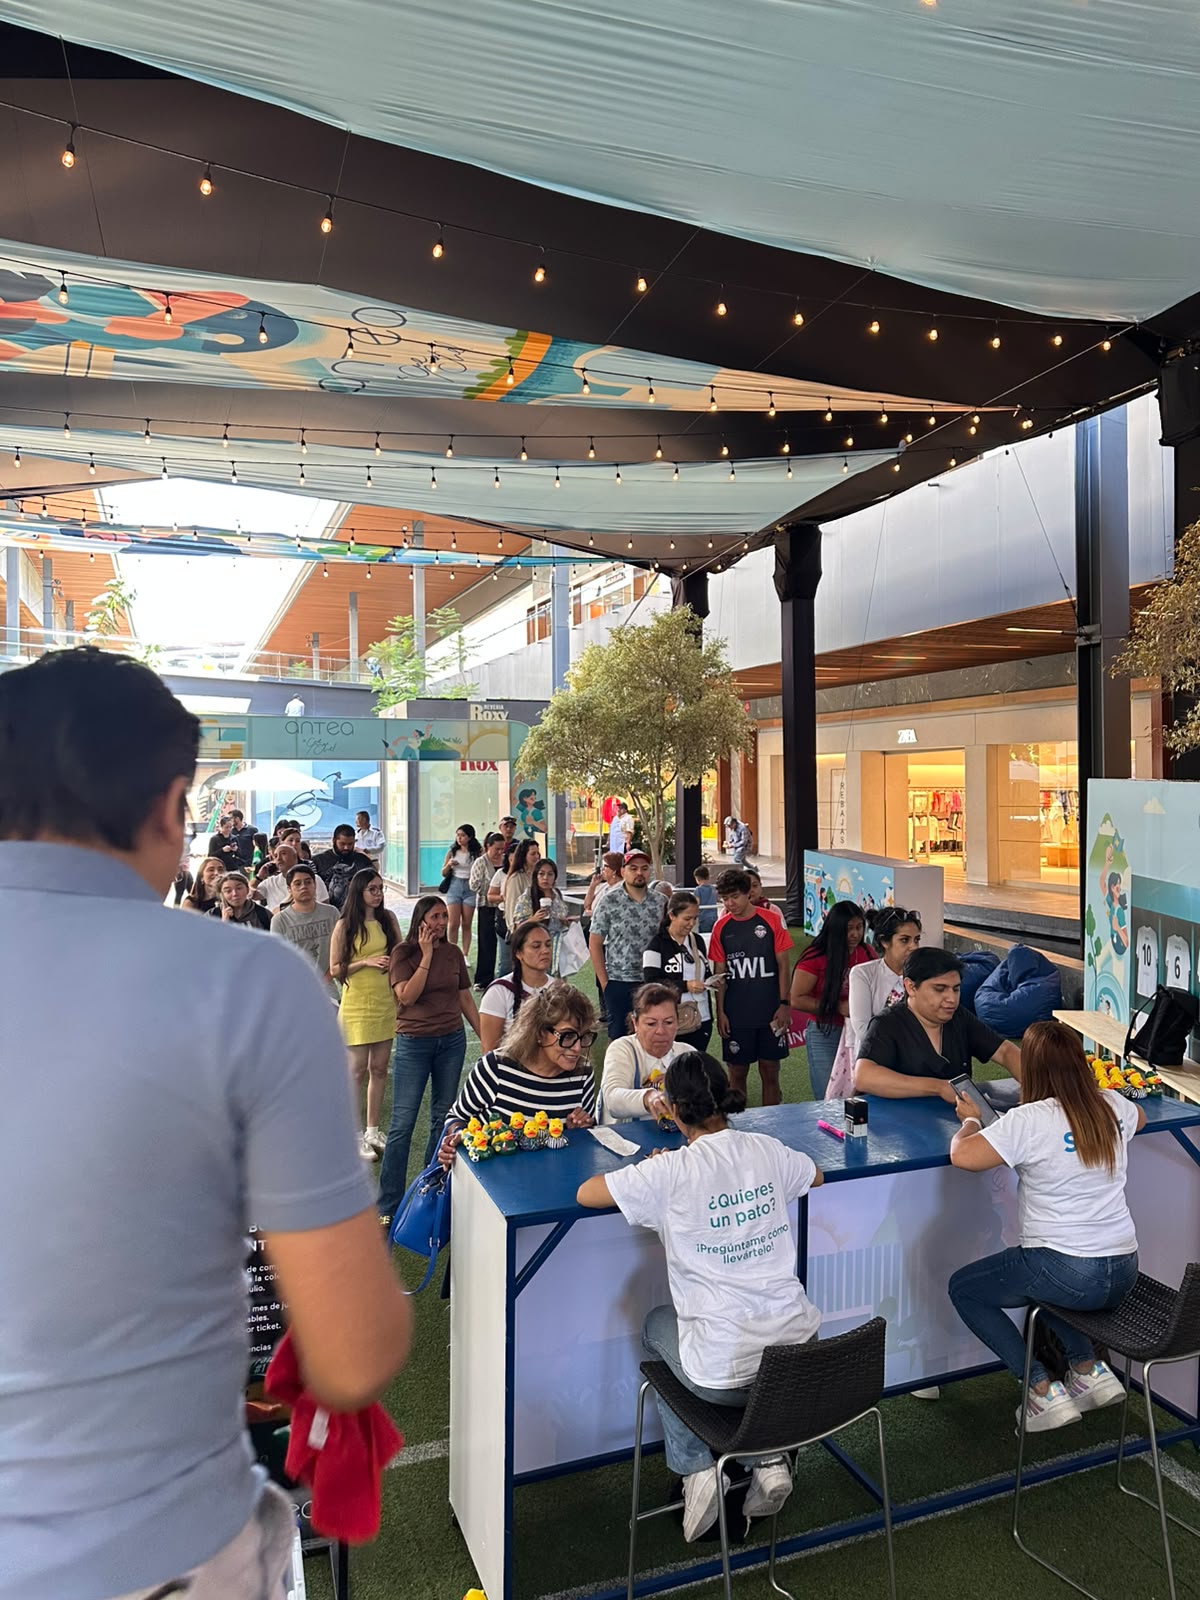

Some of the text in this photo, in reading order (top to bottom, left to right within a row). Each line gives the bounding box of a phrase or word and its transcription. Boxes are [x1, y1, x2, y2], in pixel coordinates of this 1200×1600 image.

[1142, 943, 1152, 967] 10
[1175, 956, 1180, 979] 6
[708, 1182, 774, 1210] ¿Quieres
[710, 1197, 776, 1229] un pato?
[696, 1223, 789, 1255] ¡Pregúntame cómo
[723, 1241, 775, 1264] llevártelo!
[246, 1265, 257, 1273] de
[252, 1304, 268, 1313] mes
[269, 1302, 280, 1310] de
[256, 1322, 282, 1332] ticket.
